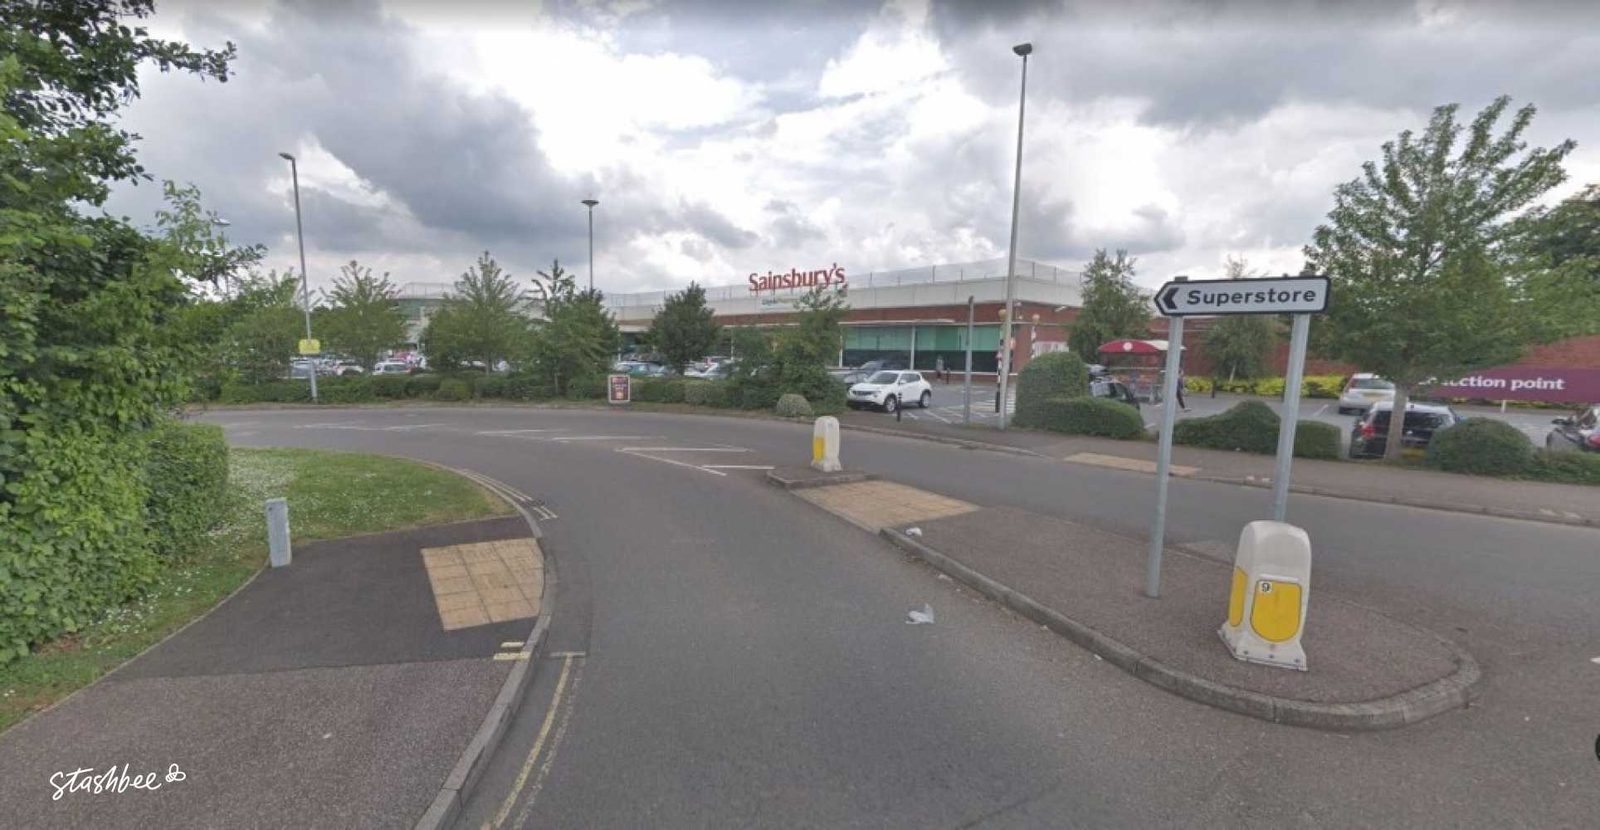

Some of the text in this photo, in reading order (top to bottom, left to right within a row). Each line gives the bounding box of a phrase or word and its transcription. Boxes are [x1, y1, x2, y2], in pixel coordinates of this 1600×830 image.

[748, 262, 845, 291] Sainsbury's
[1186, 287, 1317, 307] Superstore
[1510, 376, 1566, 391] point
